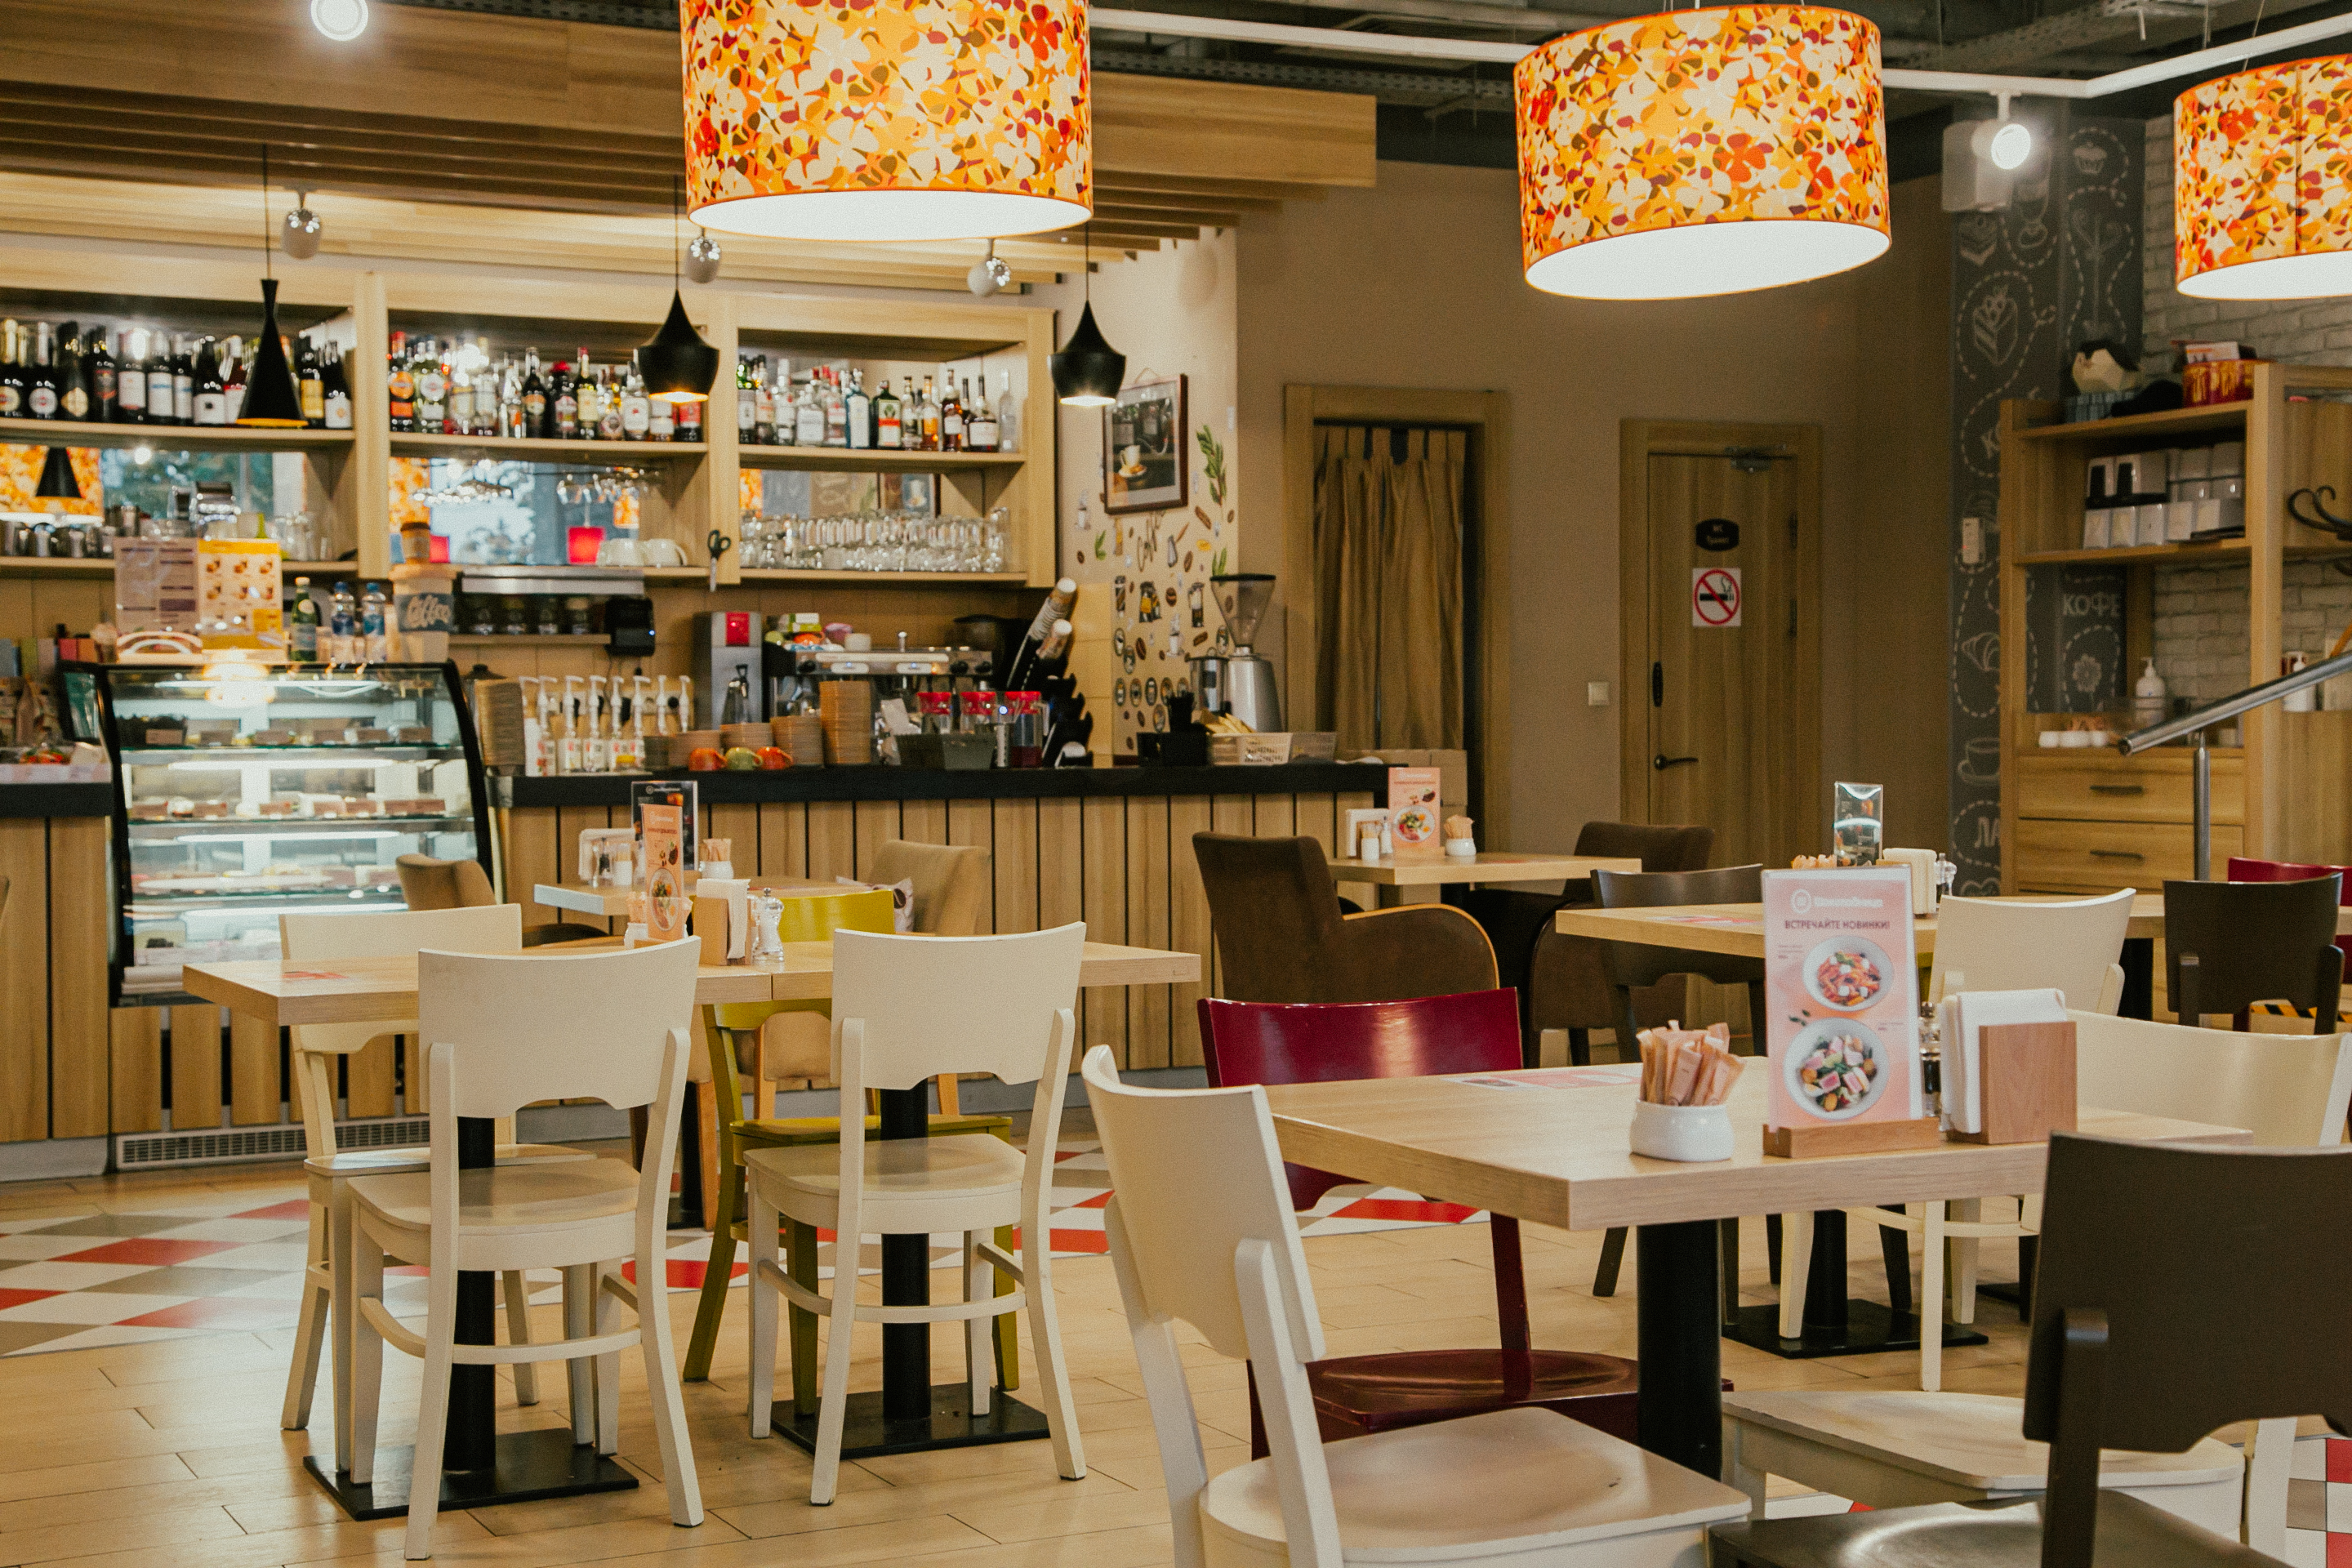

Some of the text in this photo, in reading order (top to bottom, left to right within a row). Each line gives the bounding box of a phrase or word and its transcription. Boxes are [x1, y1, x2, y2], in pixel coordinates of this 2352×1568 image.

[2062, 591, 2121, 617] КОФЕ
[1784, 918, 1891, 929] ВСТРЕЧАЙТЕ НОВИНКИ!
